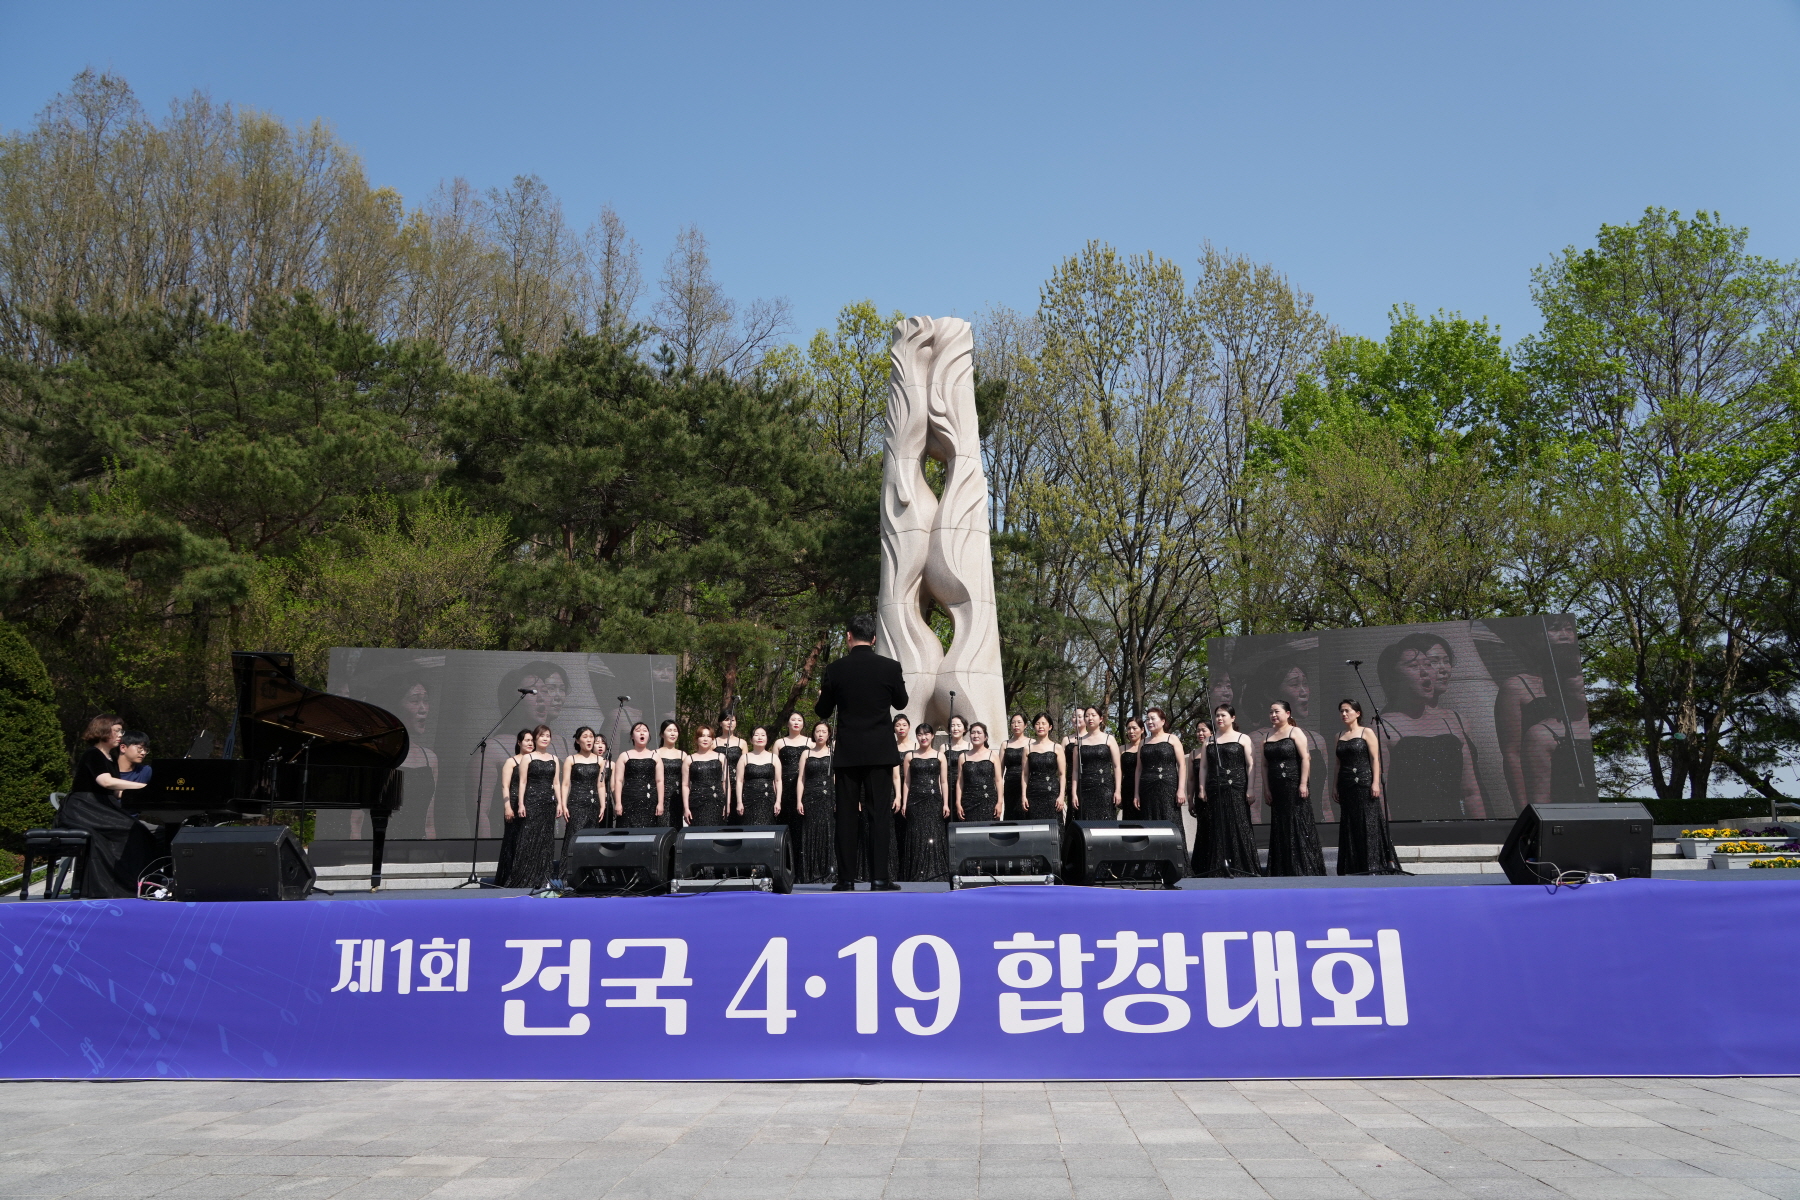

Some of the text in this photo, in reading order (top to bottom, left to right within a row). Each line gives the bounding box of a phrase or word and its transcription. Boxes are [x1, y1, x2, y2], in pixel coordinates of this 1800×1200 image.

[330, 937, 471, 995] 제1회
[501, 937, 693, 1037] 전국
[993, 927, 1409, 1035] 합창대회
